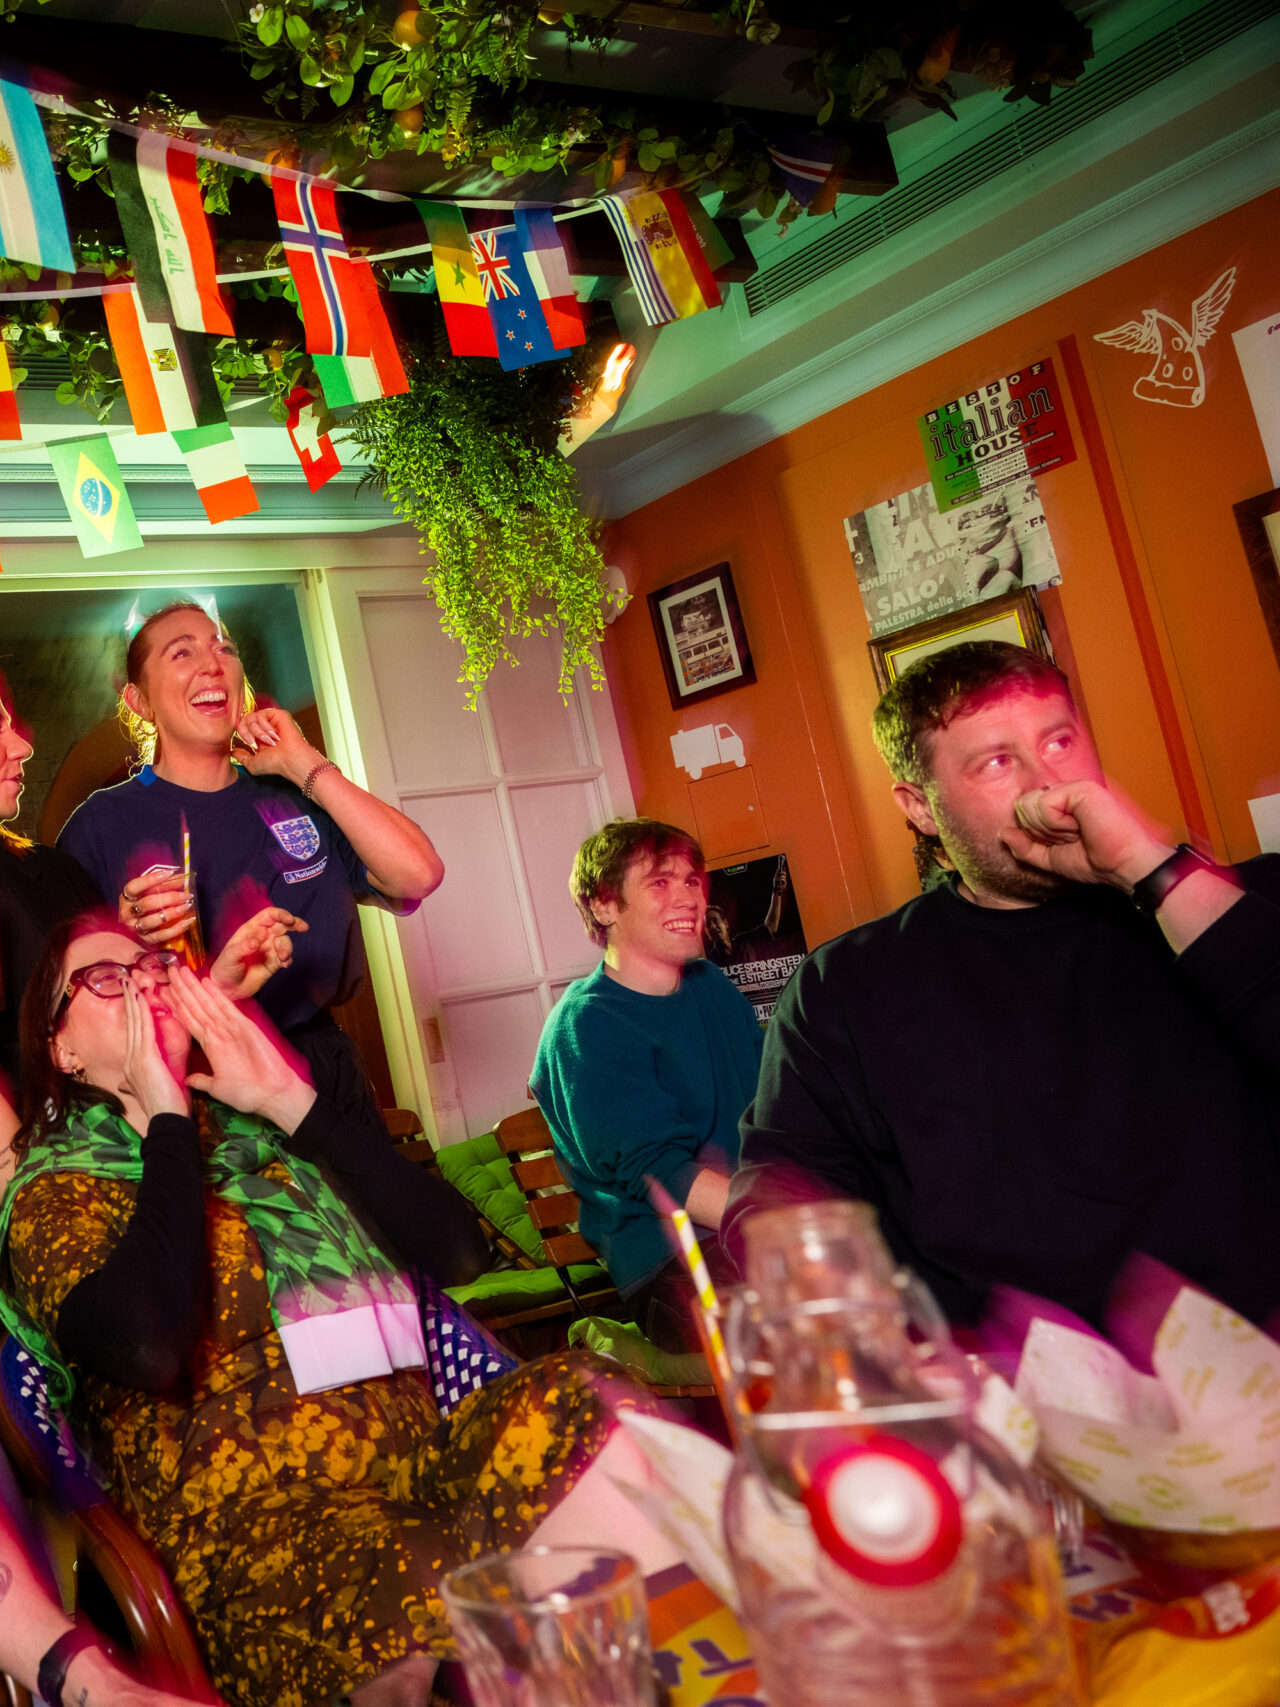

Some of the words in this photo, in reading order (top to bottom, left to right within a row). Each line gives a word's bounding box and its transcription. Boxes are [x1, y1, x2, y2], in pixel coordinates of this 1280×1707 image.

[927, 383, 1001, 424] BEST
[1008, 363, 1042, 385] OF
[930, 386, 1055, 461] italian
[955, 422, 1039, 468] HOUSE
[875, 606, 924, 632] PALESTRA
[926, 596, 953, 612] della
[720, 963, 743, 976] RUCE
[744, 953, 805, 974] SPRINGSTEEN
[747, 969, 780, 983] STREET
